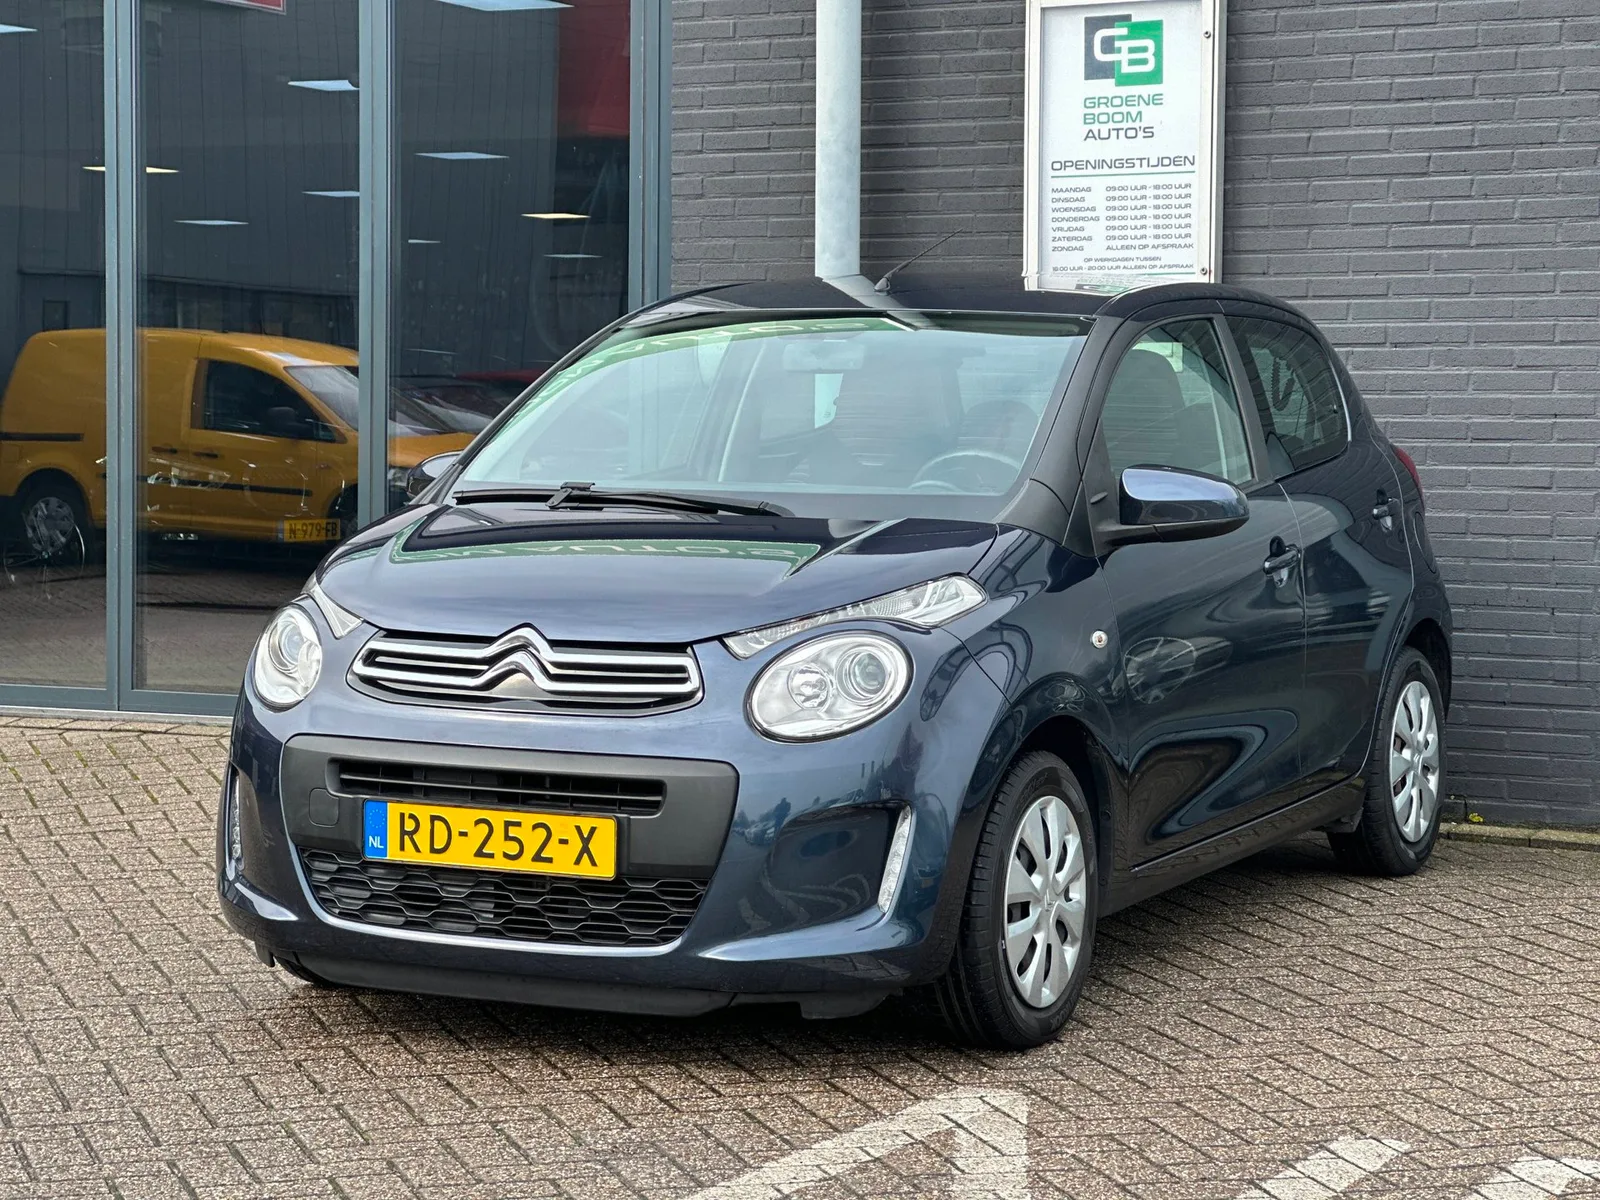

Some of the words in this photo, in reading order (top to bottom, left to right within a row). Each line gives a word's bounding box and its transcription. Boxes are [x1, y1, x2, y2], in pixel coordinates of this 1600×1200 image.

[1084, 93, 1164, 109] GROENE
[1083, 110, 1142, 125] BOOM
[1084, 126, 1154, 142] AUTO'S
[1051, 155, 1195, 171] OPENINGSTIJDEN
[368, 836, 384, 849] NL
[399, 812, 598, 867] RD-252-X
